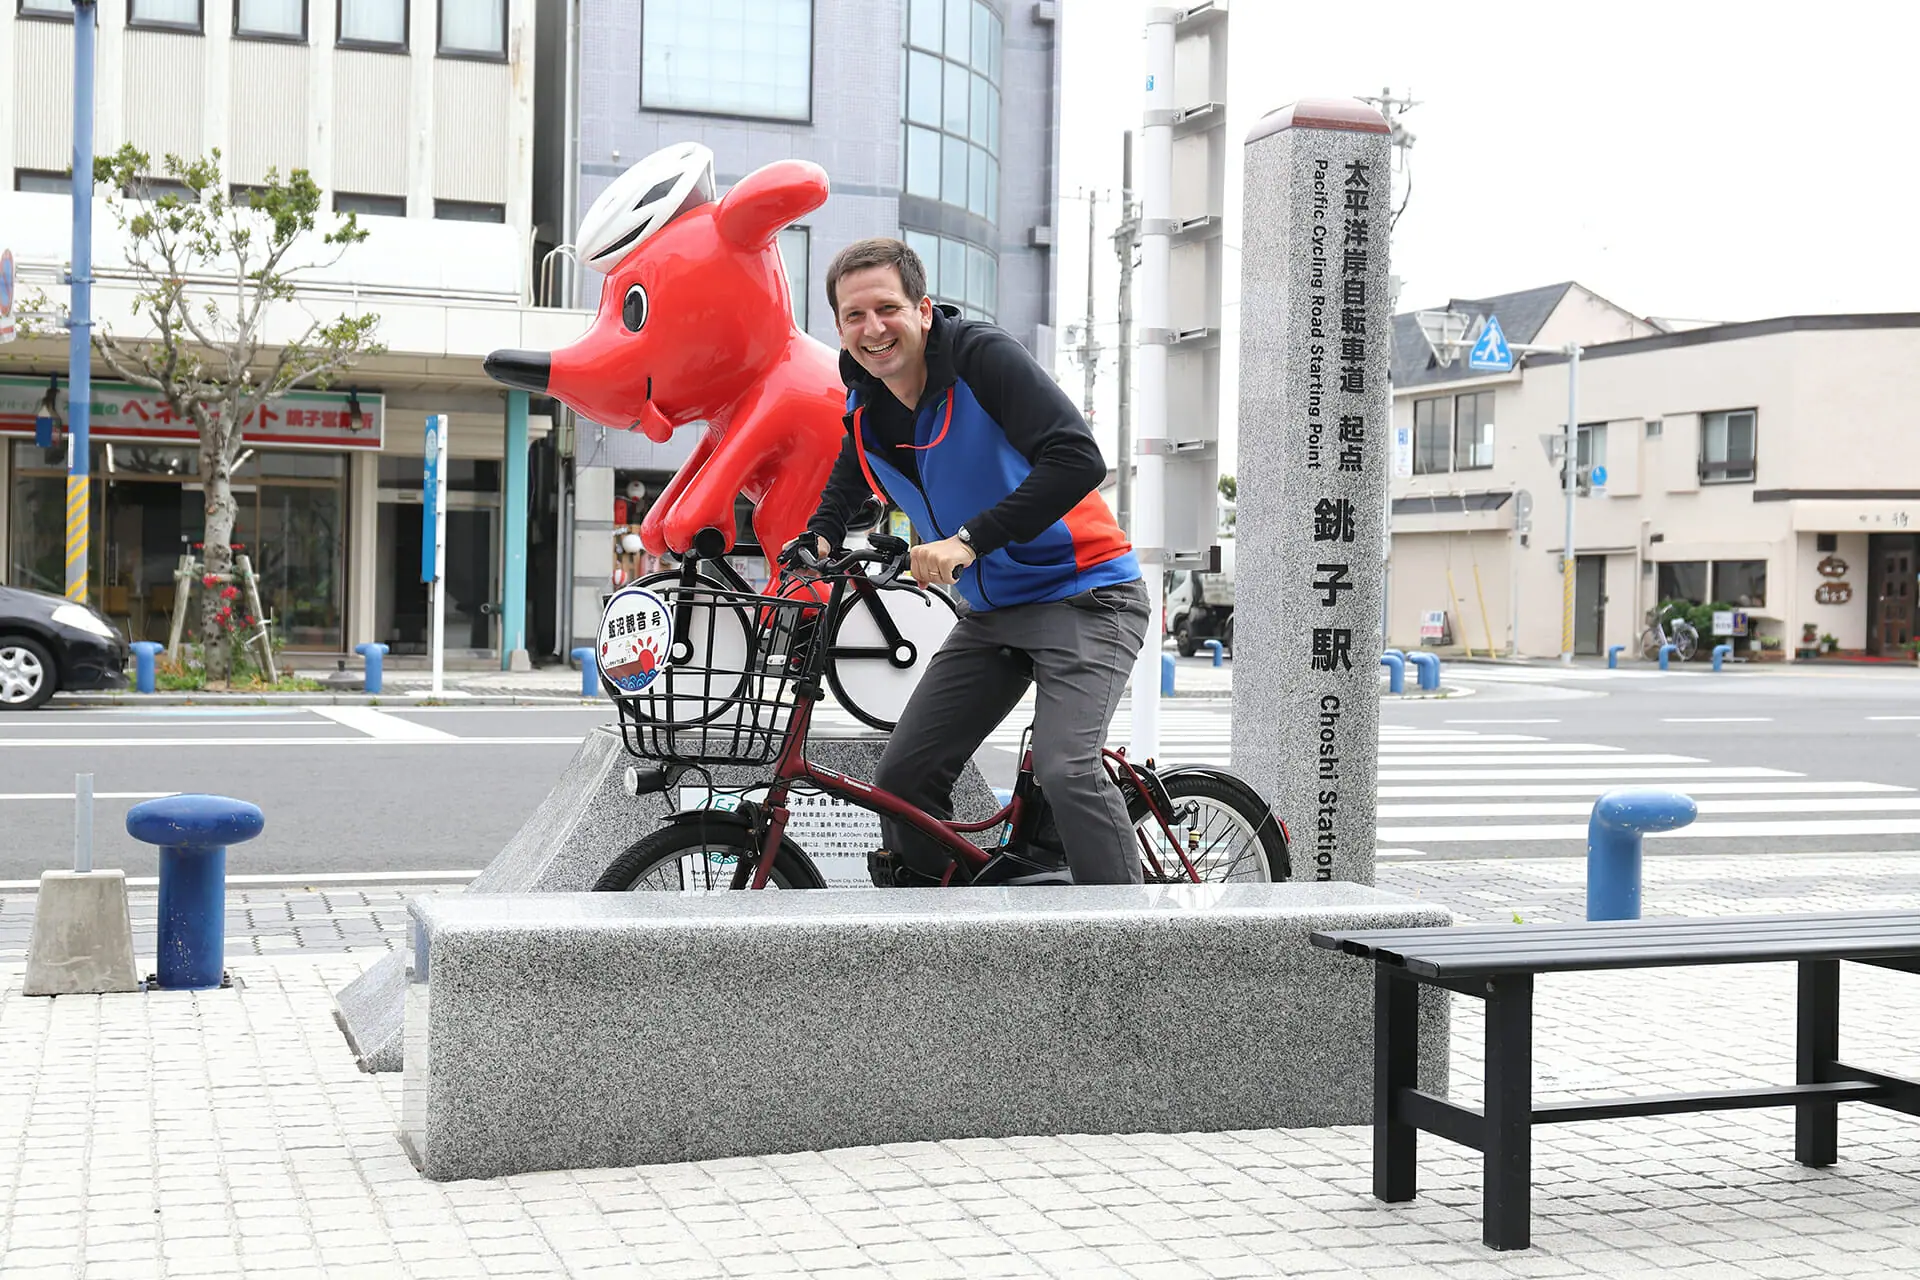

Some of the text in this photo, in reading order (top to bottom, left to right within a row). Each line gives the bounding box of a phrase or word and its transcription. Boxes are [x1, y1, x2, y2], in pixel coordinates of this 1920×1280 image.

[1308, 159, 1328, 469] Pacific Cycling Road Starting Point
[1338, 160, 1369, 472] 太平洋岸自転車道 起点
[1311, 498, 1355, 672] 銚子駅
[1316, 695, 1340, 881] Choshi Station
